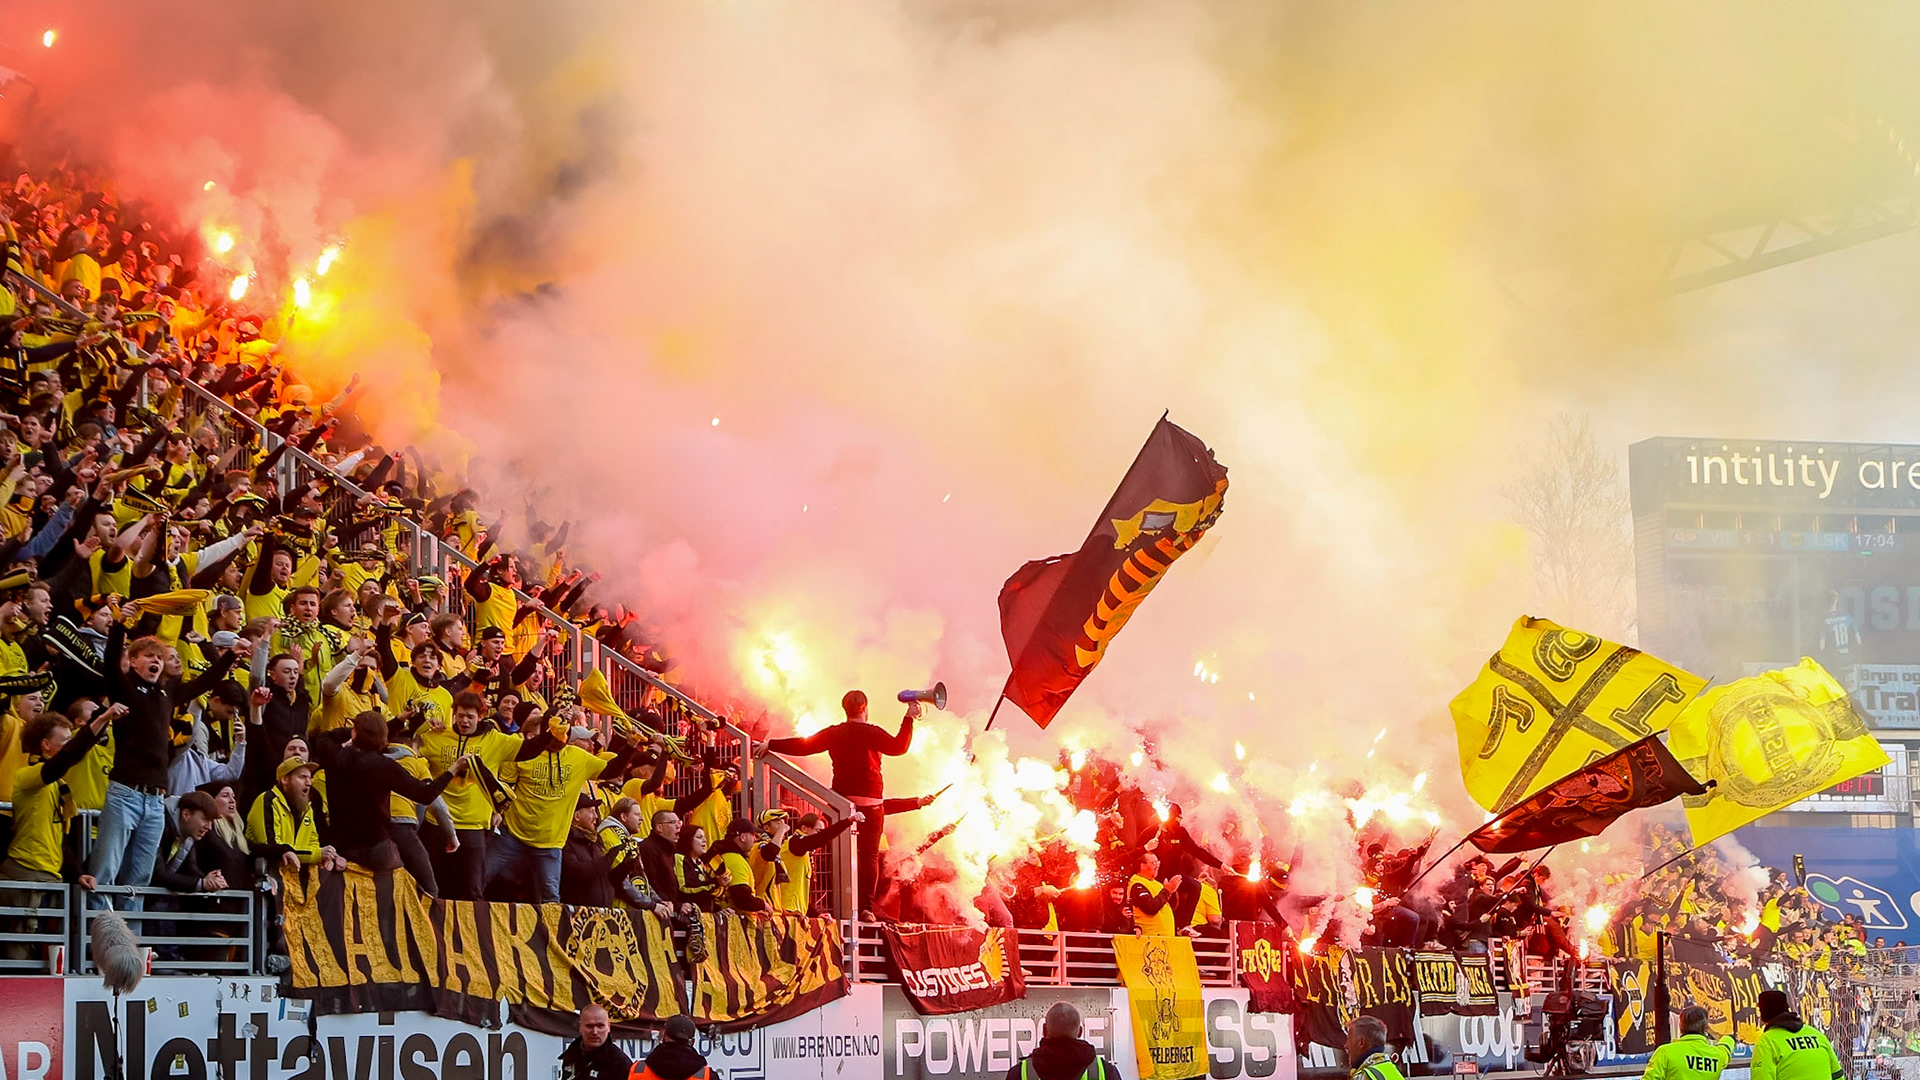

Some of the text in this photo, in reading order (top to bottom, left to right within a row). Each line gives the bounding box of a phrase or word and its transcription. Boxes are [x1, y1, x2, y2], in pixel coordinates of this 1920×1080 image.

[1686, 444, 1840, 499] intility
[1855, 533, 1896, 547] 17:04
[1860, 669, 1898, 684] Bryn
[441, 745, 483, 764] HAER
[902, 962, 989, 997] CUSTODES
[1294, 951, 1412, 1008] LTRAS
[771, 1034, 880, 1059] WWW.BRENDEN.NO
[1785, 1036, 1820, 1051] VERT
[1685, 1055, 1719, 1072] VERT
